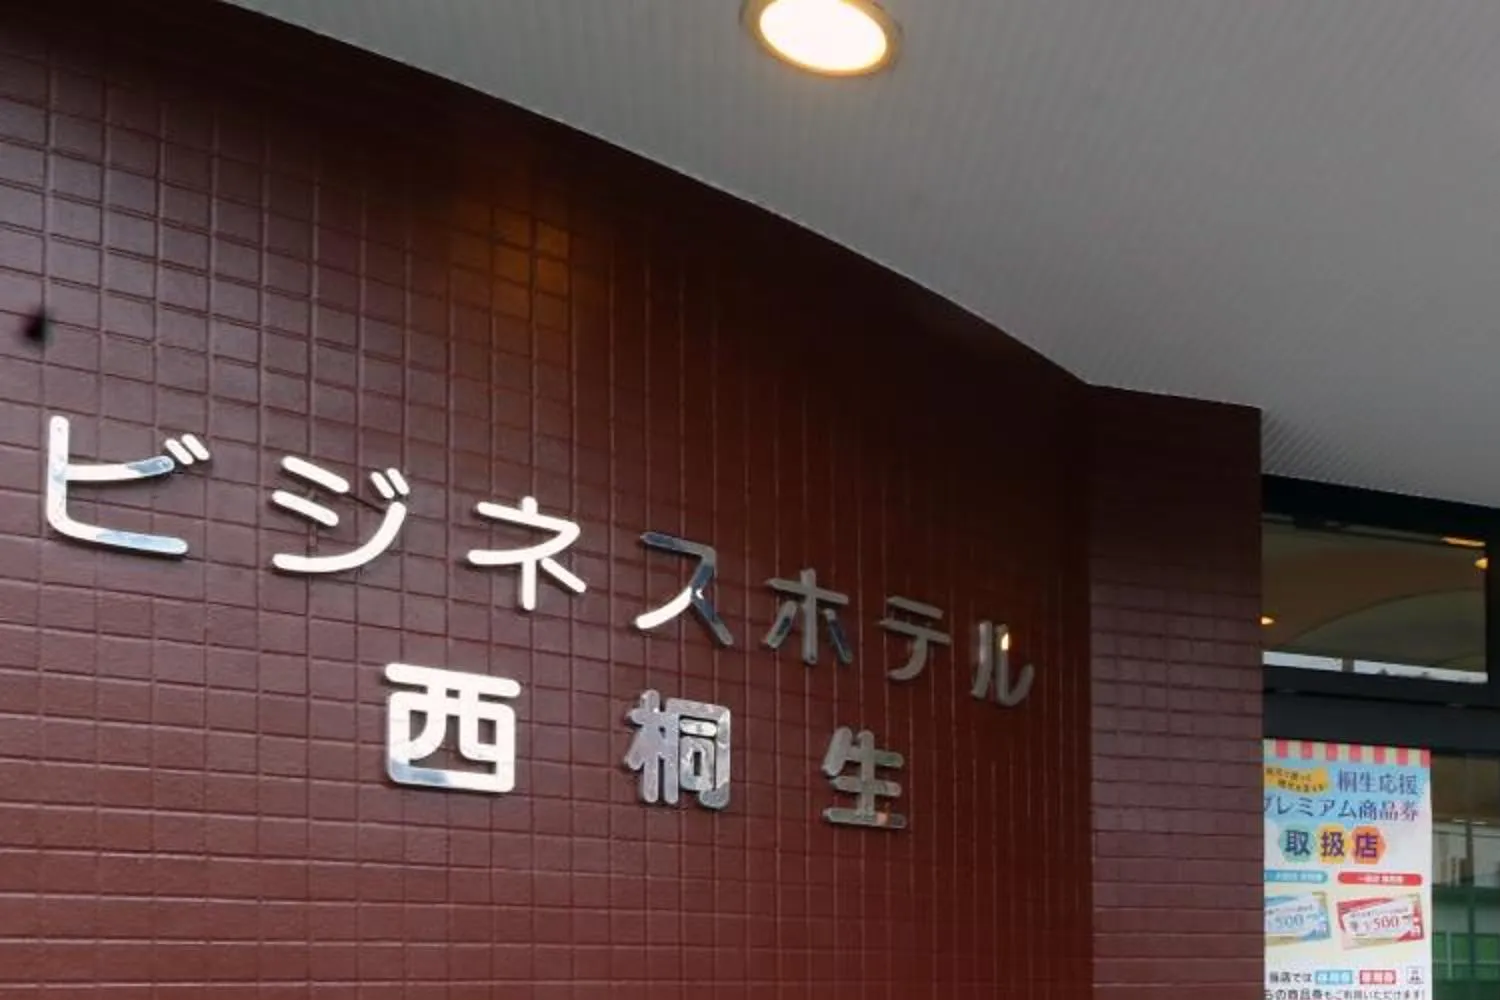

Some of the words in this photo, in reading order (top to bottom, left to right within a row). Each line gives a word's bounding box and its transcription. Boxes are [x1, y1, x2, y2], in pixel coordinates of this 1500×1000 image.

[46, 415, 1035, 708] ビジネスホテル
[384, 661, 909, 830] 西桐生
[1337, 767, 1419, 796] 桐生応援
[1284, 829, 1380, 859] 取扱店
